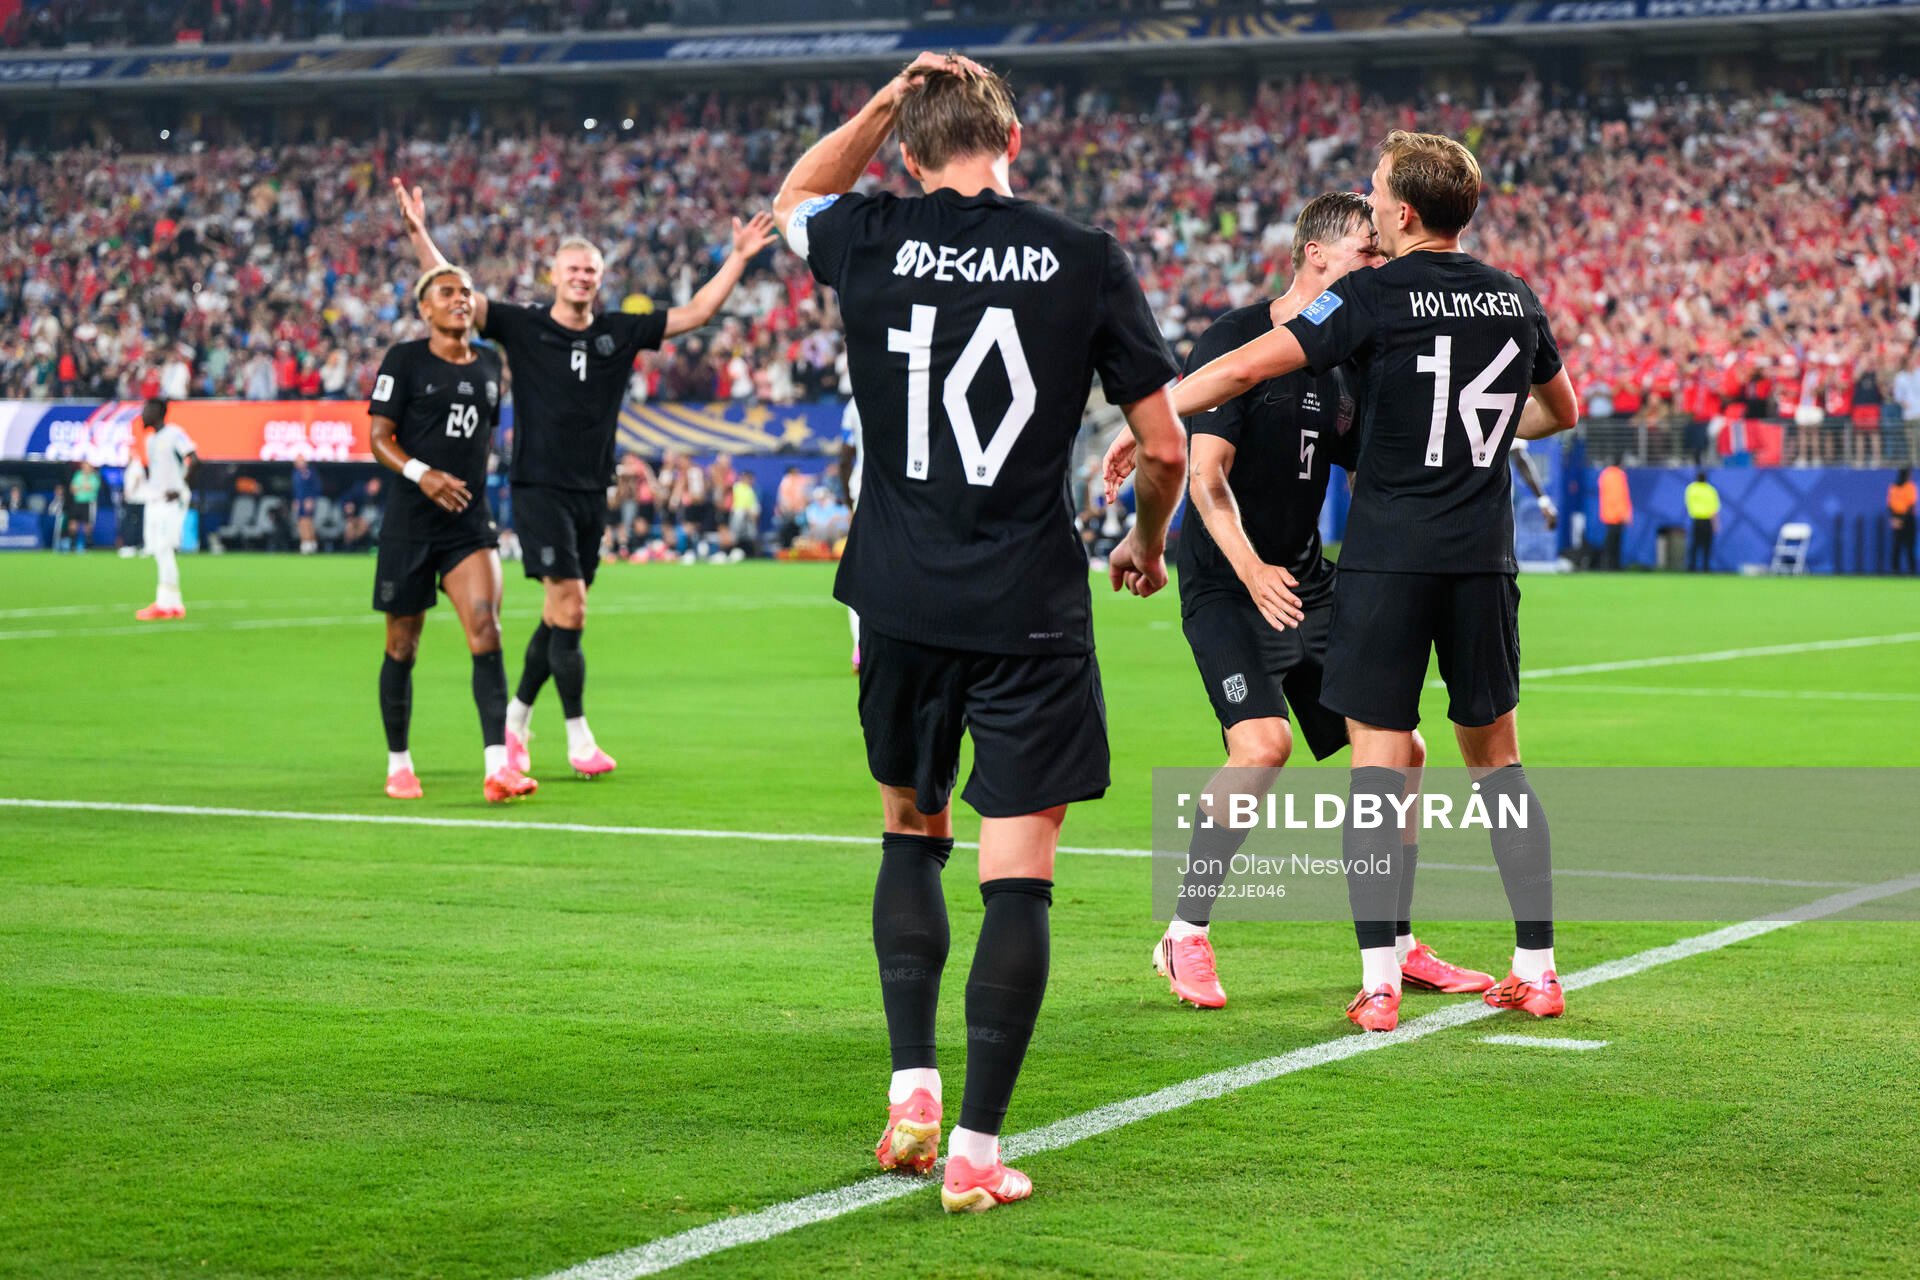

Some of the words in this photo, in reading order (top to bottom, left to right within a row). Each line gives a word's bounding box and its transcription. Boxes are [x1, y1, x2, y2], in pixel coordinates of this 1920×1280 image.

[893, 240, 1059, 282] ØDEGAARD
[1409, 291, 1524, 317] HOLMGREN
[571, 350, 587, 381] 9
[888, 304, 1037, 487] 10
[1416, 335, 1520, 468] 16
[446, 403, 479, 438] 20
[1299, 429, 1319, 480] 5
